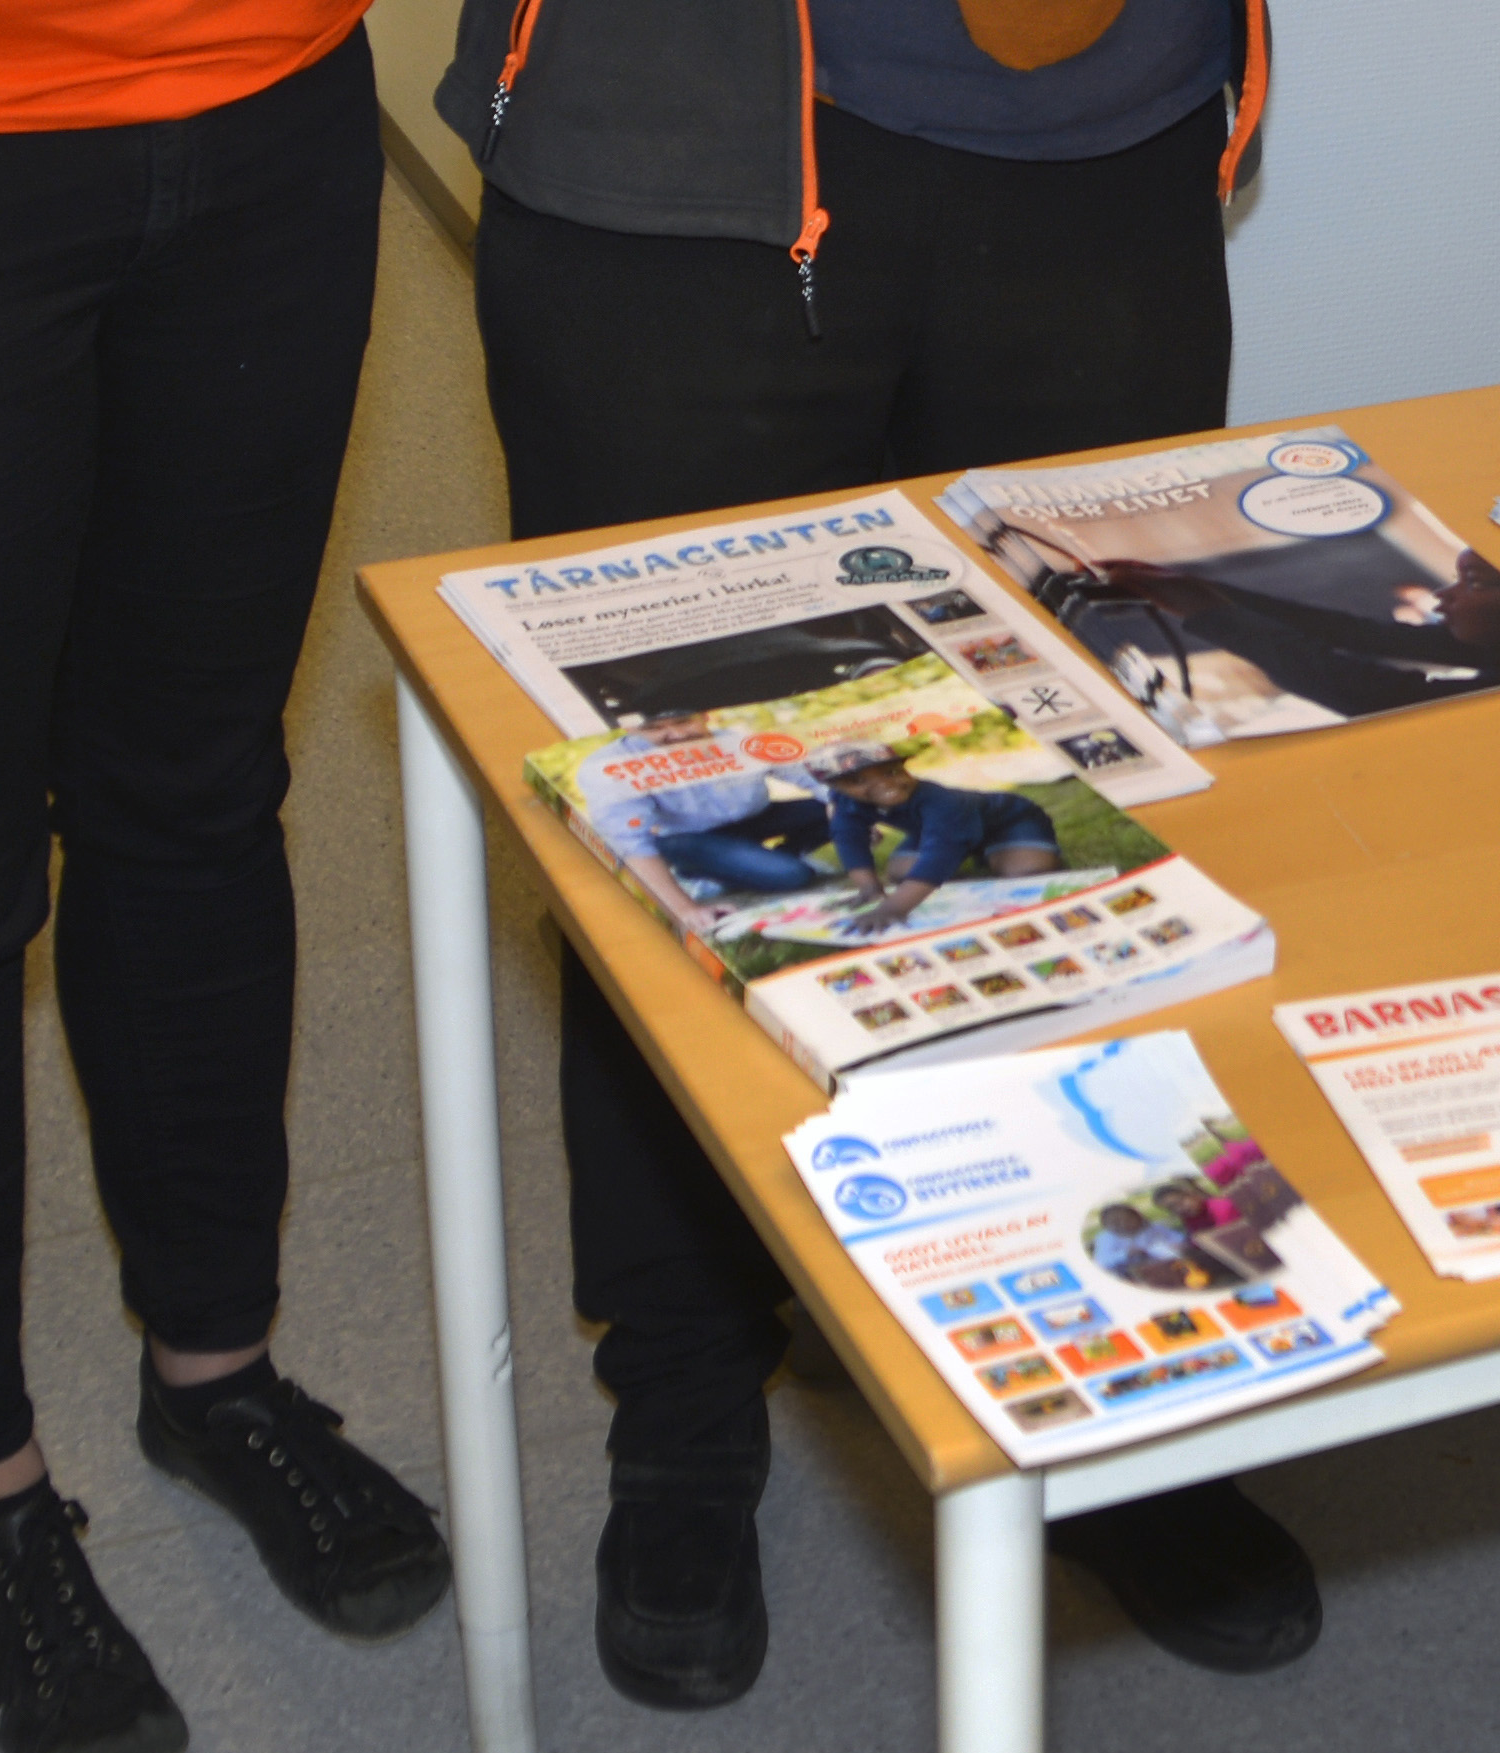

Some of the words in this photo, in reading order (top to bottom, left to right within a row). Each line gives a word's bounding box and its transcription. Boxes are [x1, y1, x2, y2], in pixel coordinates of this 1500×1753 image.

[1010, 503, 1105, 520] OVER
[1113, 483, 1211, 513] LIVET
[485, 506, 896, 599] TÅRNAGENTEN
[595, 592, 701, 620] mysterier
[721, 573, 791, 596] kirka!
[603, 744, 735, 779] SPRELL
[631, 758, 744, 791] LEVENDE
